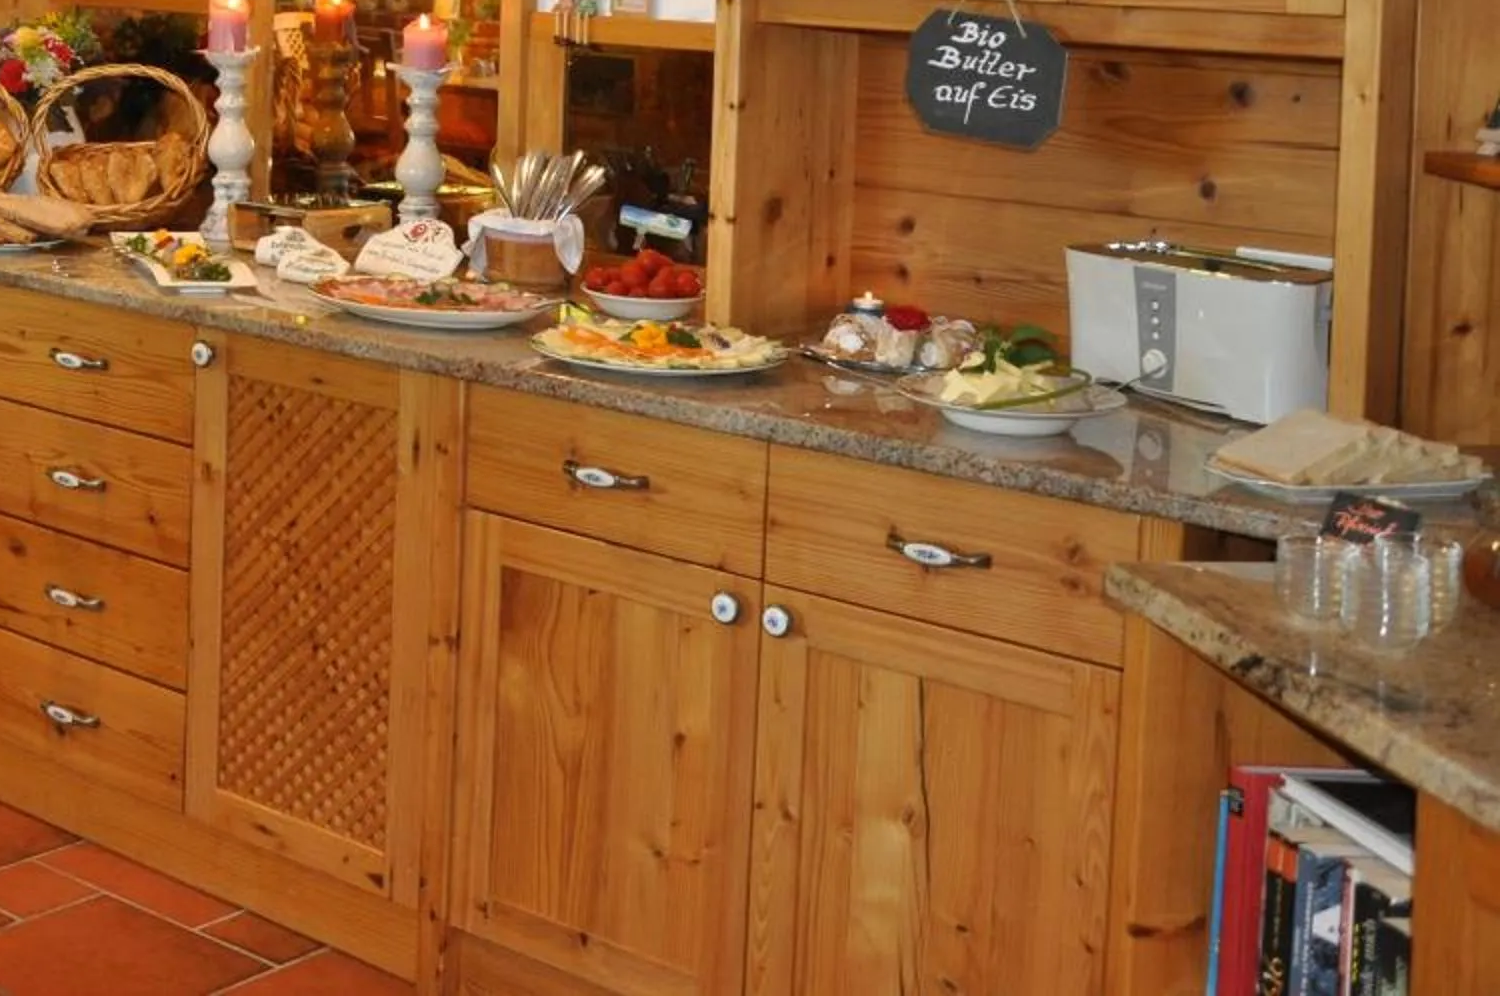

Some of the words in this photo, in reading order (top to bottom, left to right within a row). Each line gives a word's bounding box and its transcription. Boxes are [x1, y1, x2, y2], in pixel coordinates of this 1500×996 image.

[951, 21, 1007, 49] Bio
[927, 45, 1037, 80] Butter
[934, 81, 987, 124] auf
[987, 85, 1037, 111] Eis
